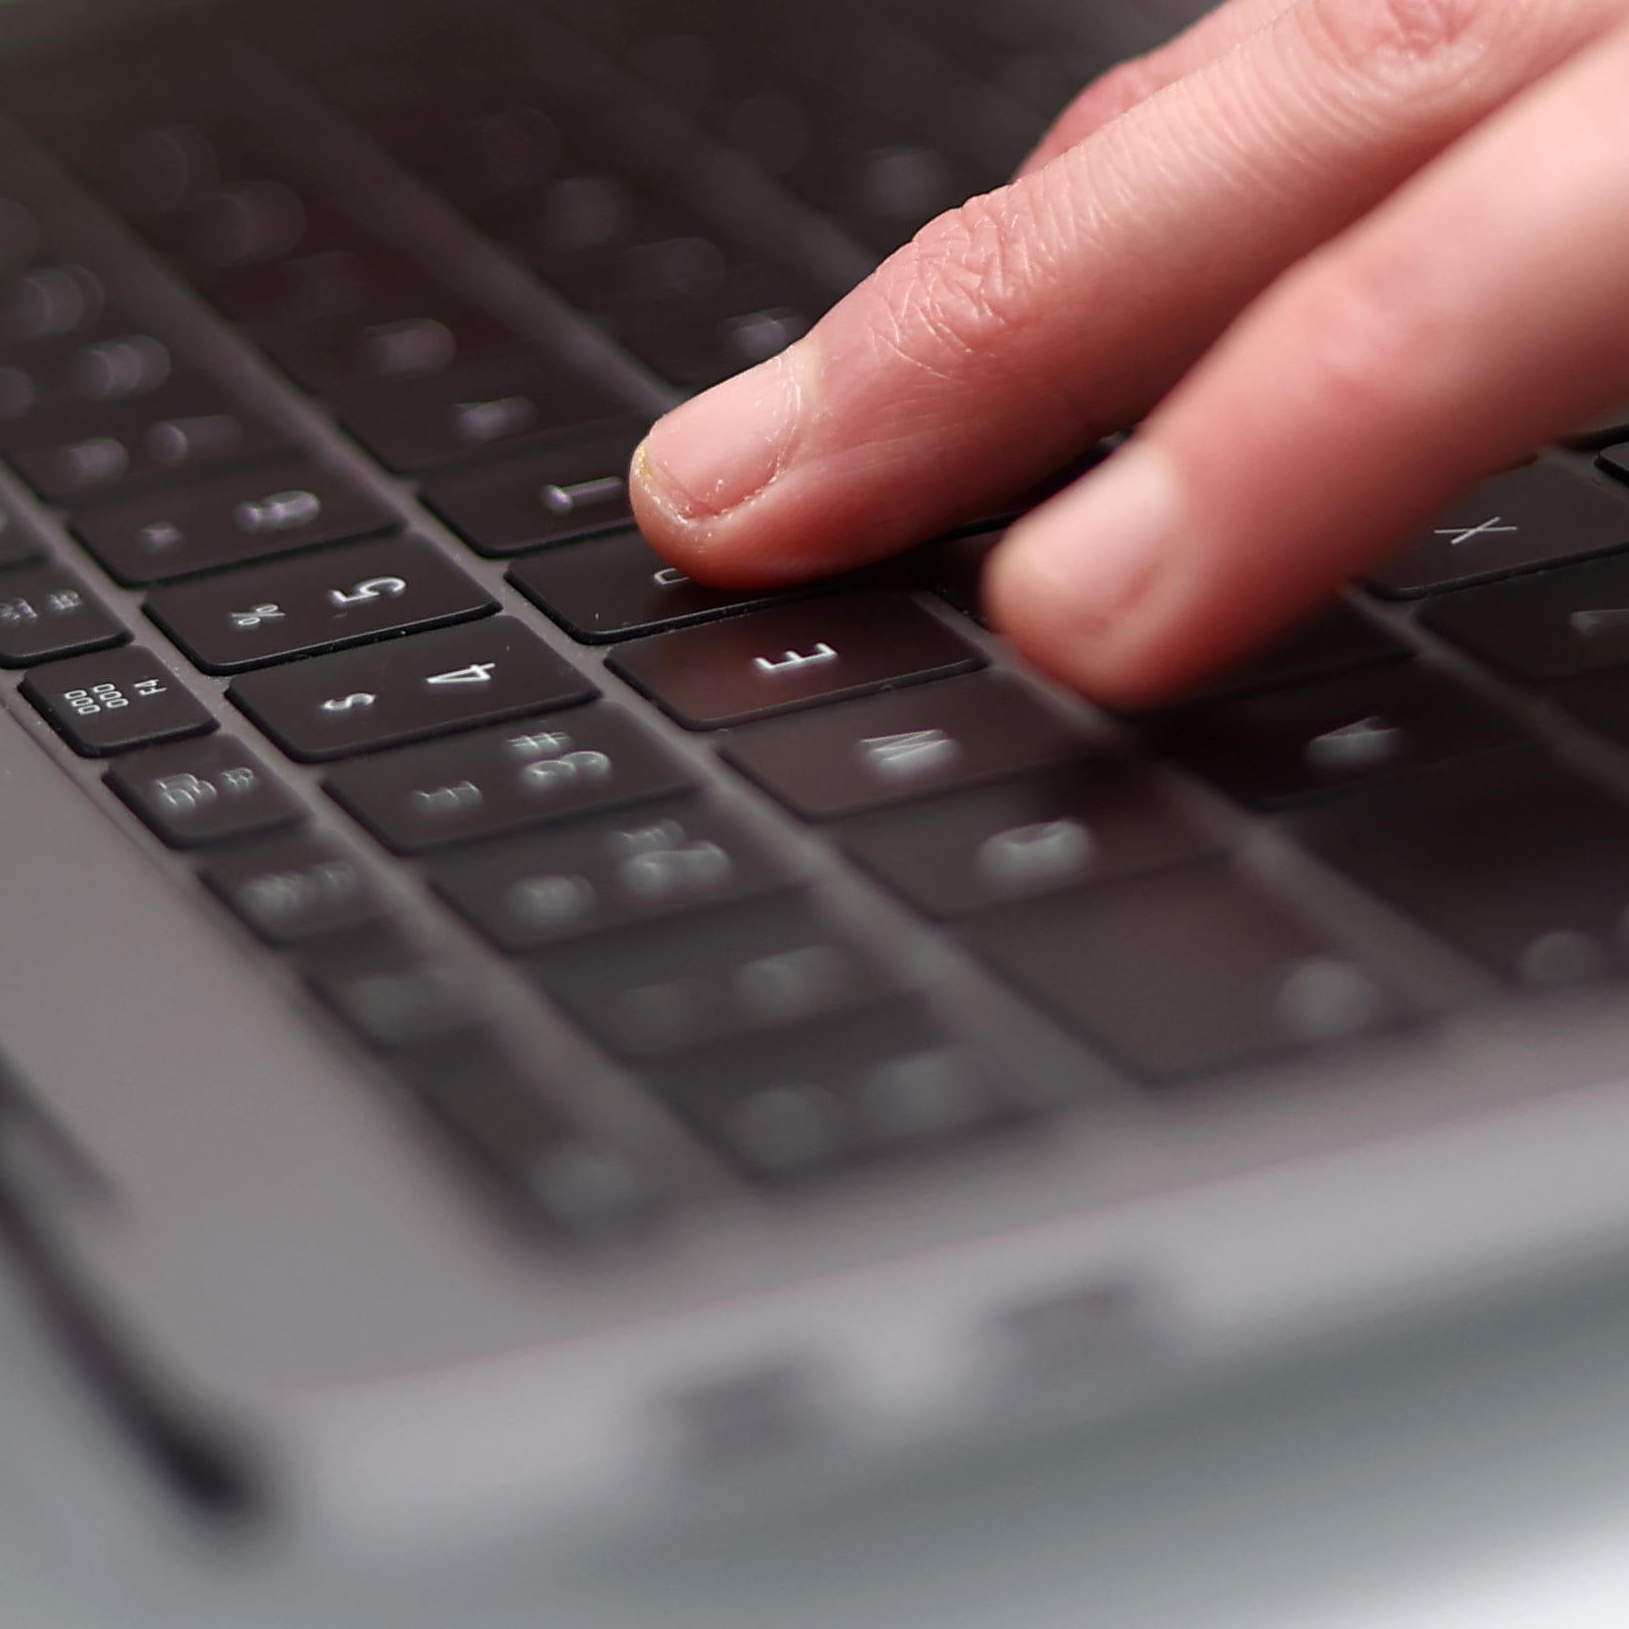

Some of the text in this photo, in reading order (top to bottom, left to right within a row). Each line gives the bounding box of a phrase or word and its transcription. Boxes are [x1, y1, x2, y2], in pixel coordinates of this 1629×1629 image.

[1434, 517, 1518, 544] X
[328, 575, 408, 604] 5
[231, 603, 286, 627] %
[754, 642, 839, 670] E
[425, 662, 497, 684] 4
[133, 678, 168, 696] F4
